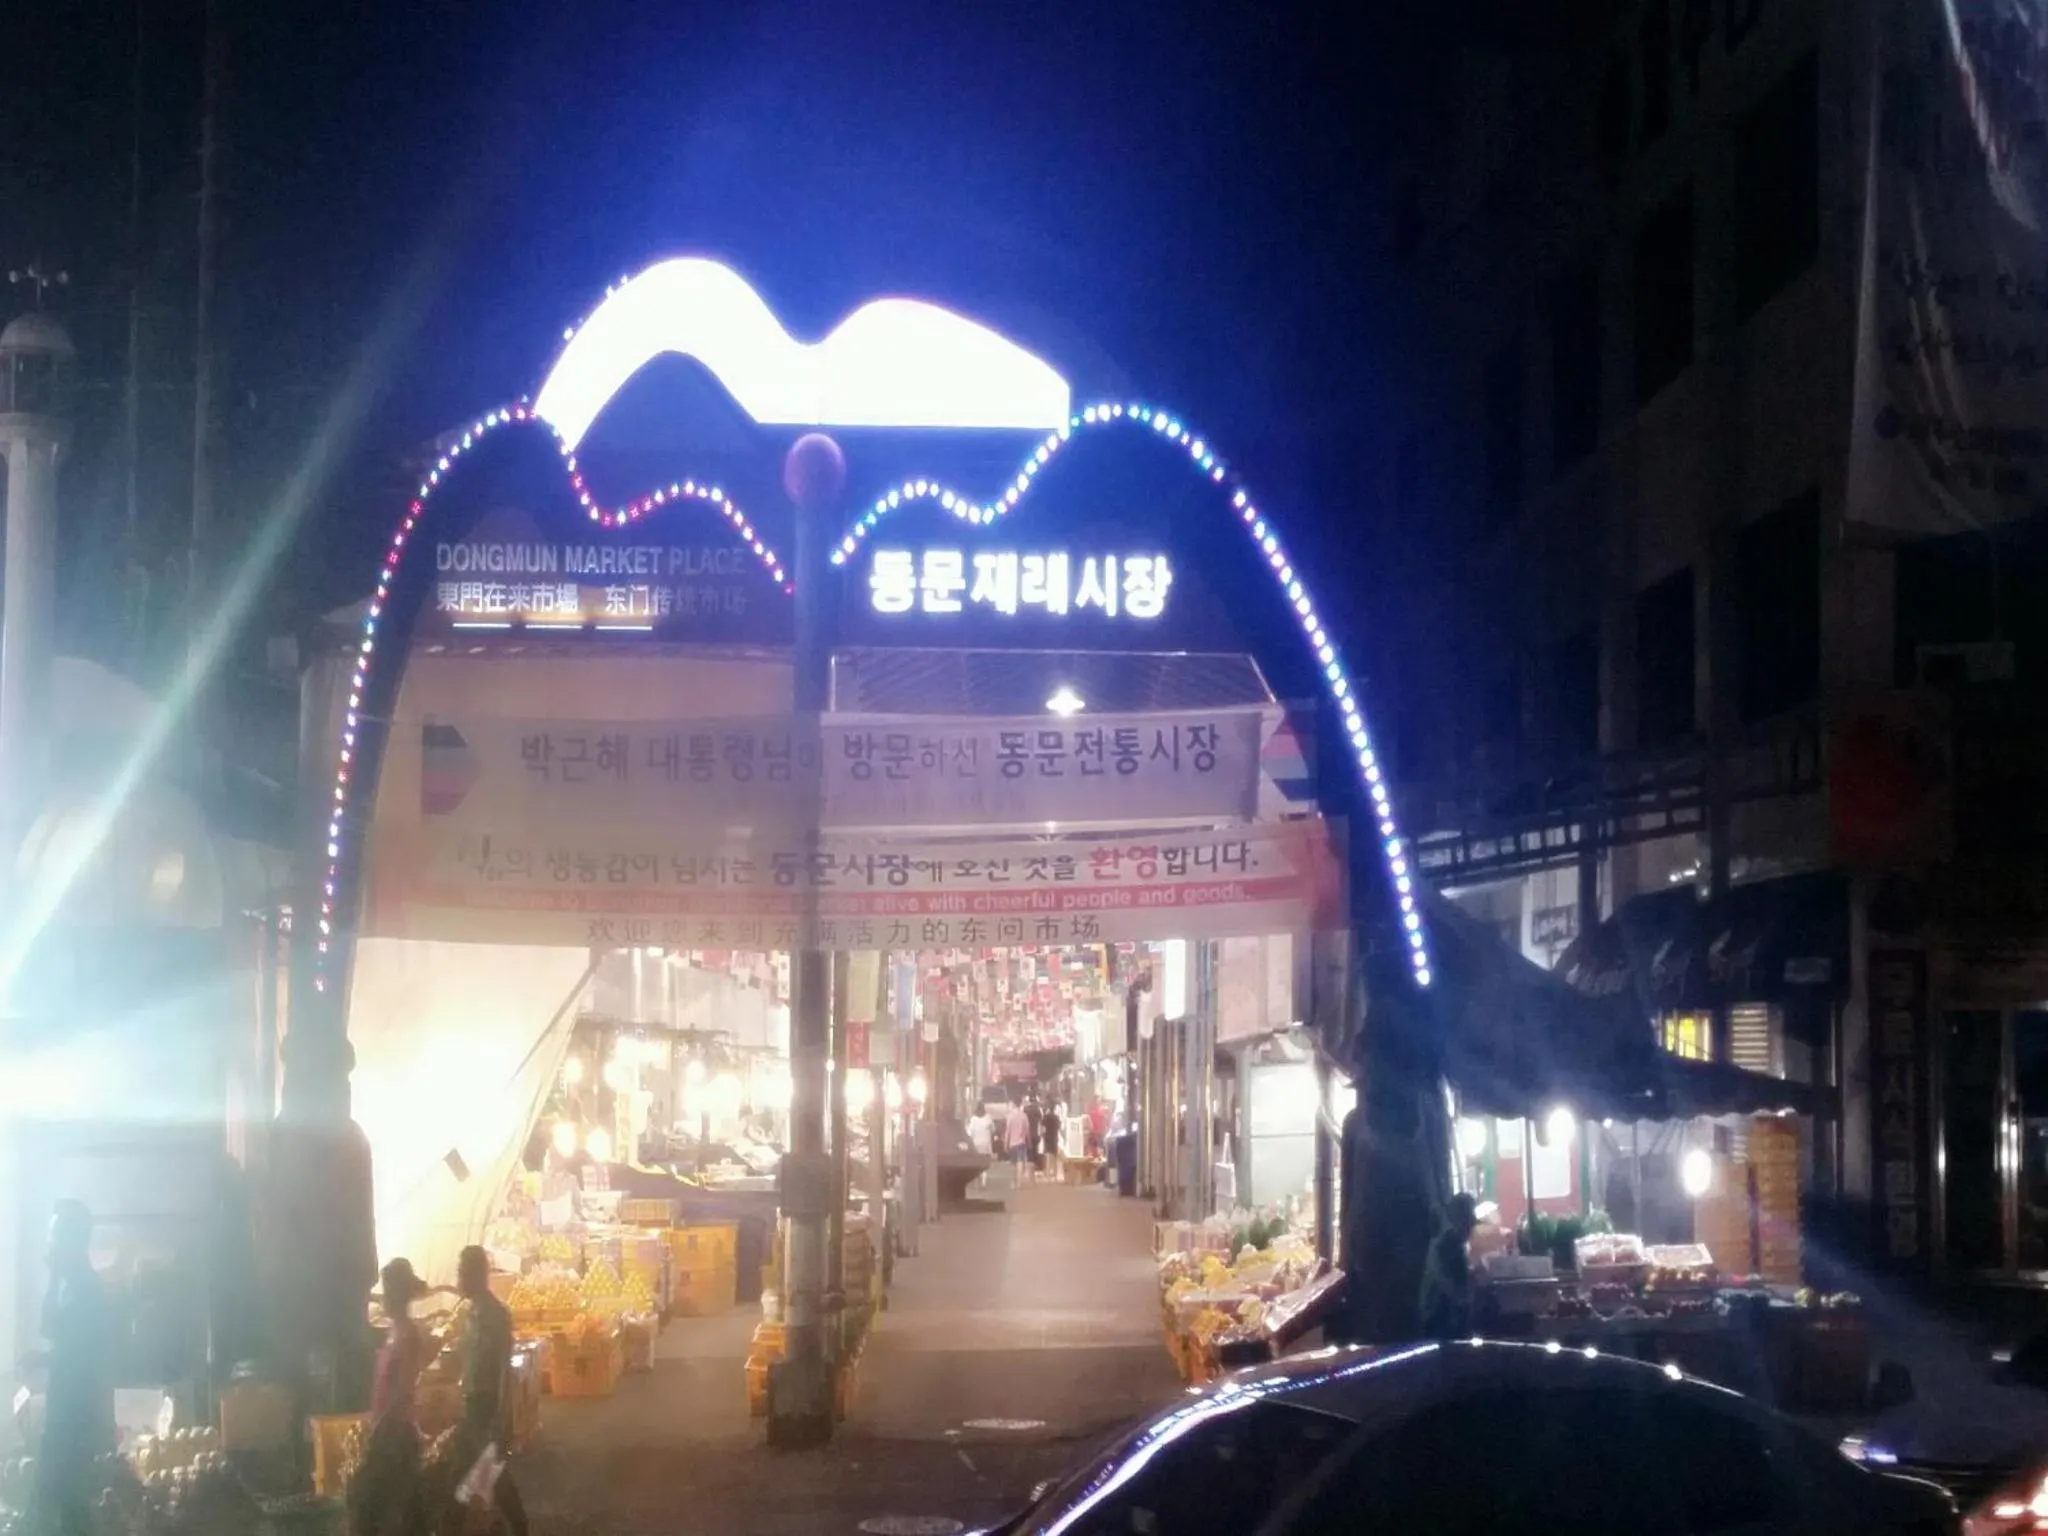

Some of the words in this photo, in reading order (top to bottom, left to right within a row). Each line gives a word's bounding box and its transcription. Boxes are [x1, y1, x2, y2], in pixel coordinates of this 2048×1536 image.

[436, 544, 557, 573] DONGMUN
[564, 546, 663, 575] MARKET
[668, 547, 746, 575] PLACE
[869, 550, 1173, 618] 동문재래시장
[520, 732, 630, 783] 박근혜
[647, 732, 824, 784] 대통령님이
[995, 723, 1221, 777] 동문전통시장
[953, 857, 1010, 882] 오신
[1023, 855, 1077, 881] 것을
[1088, 841, 1259, 880] 환영합니다.
[928, 891, 966, 912] with
[973, 889, 1055, 911] cheerful
[1063, 889, 1132, 909] people
[1138, 884, 1176, 905] and
